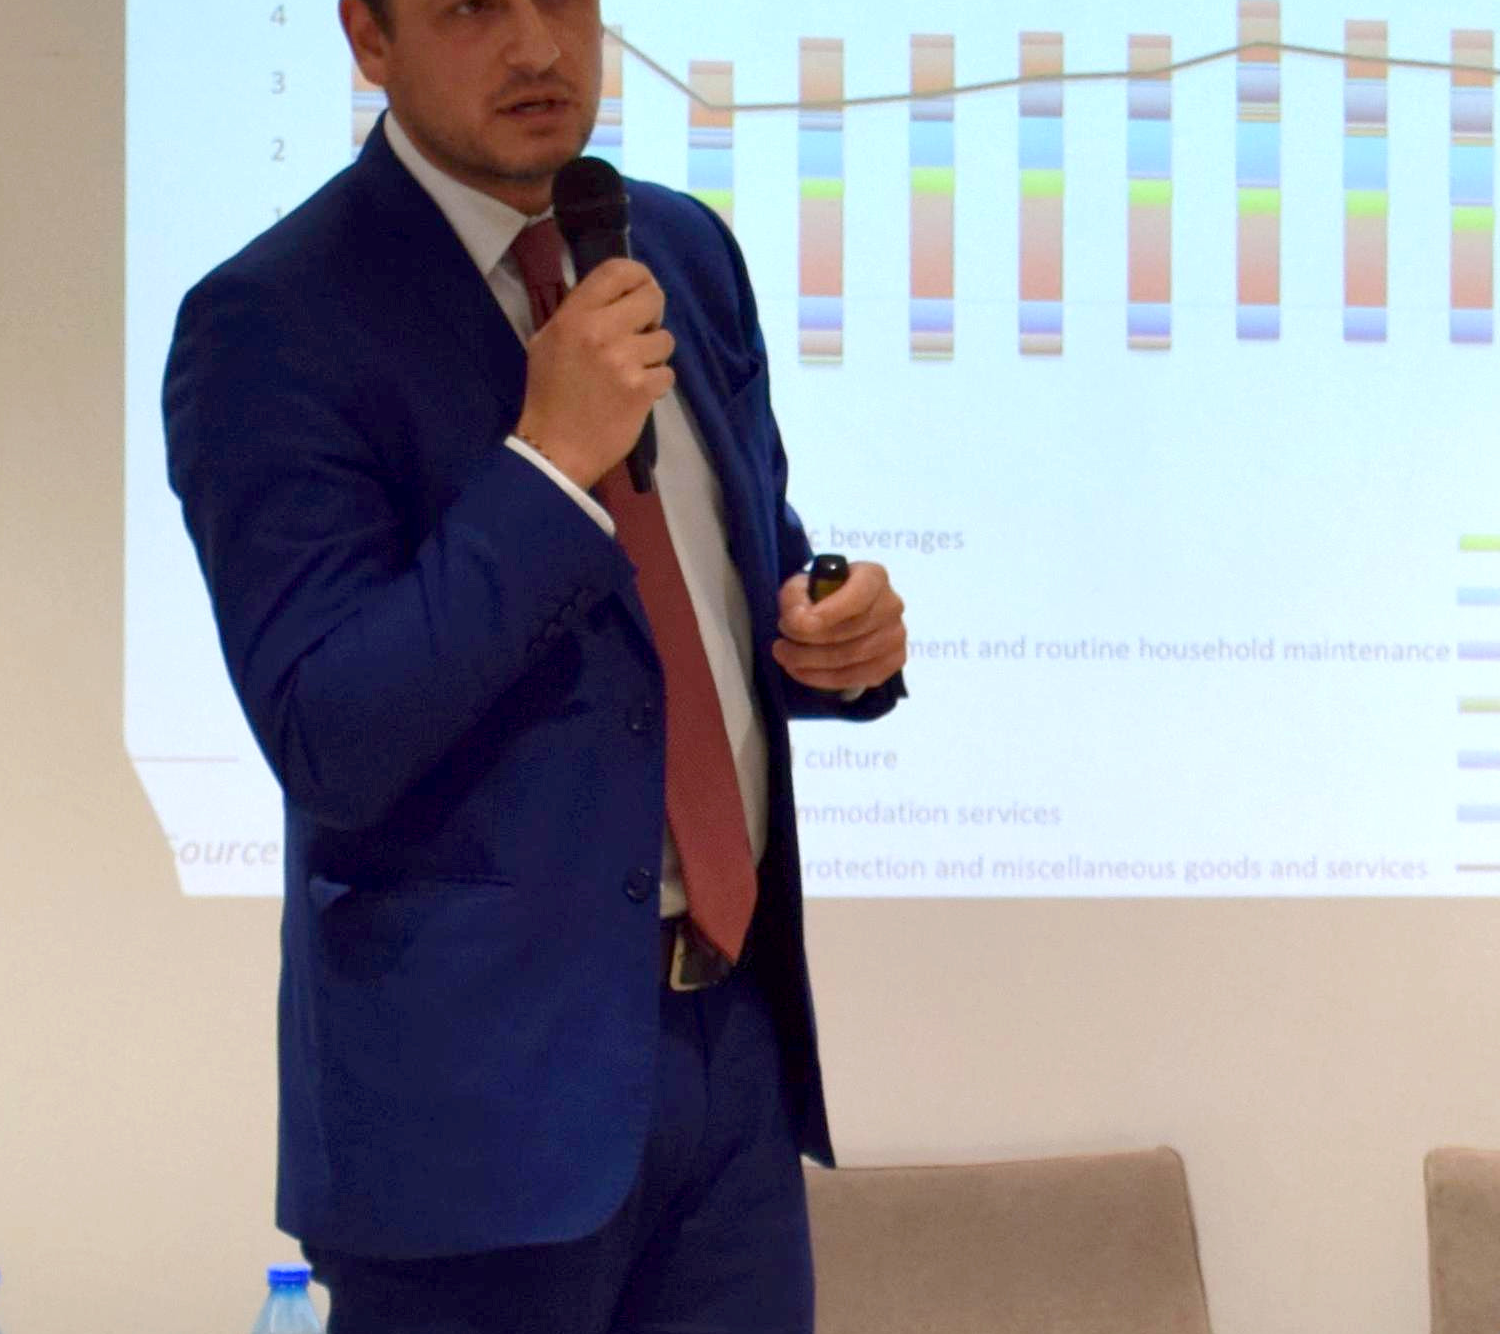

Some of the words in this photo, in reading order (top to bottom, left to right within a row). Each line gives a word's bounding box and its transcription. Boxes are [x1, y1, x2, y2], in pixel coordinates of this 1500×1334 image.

[269, 3, 288, 28] 4
[270, 70, 286, 95] 3
[270, 136, 286, 162] 2
[829, 524, 966, 555] beverages
[907, 637, 969, 660] ment
[979, 636, 1027, 660] and
[1035, 636, 1131, 660] routine
[1139, 635, 1275, 661] household
[1282, 637, 1451, 662] maintenance
[804, 746, 898, 770] culture
[799, 799, 949, 826] mmodation
[956, 800, 1062, 826] services
[178, 837, 280, 867] ource
[803, 855, 928, 881] rotection
[934, 854, 985, 881] and
[991, 854, 1177, 881] miscellaneous
[1183, 854, 1262, 885] goods
[1269, 854, 1318, 880] and
[1325, 854, 1430, 880] services
